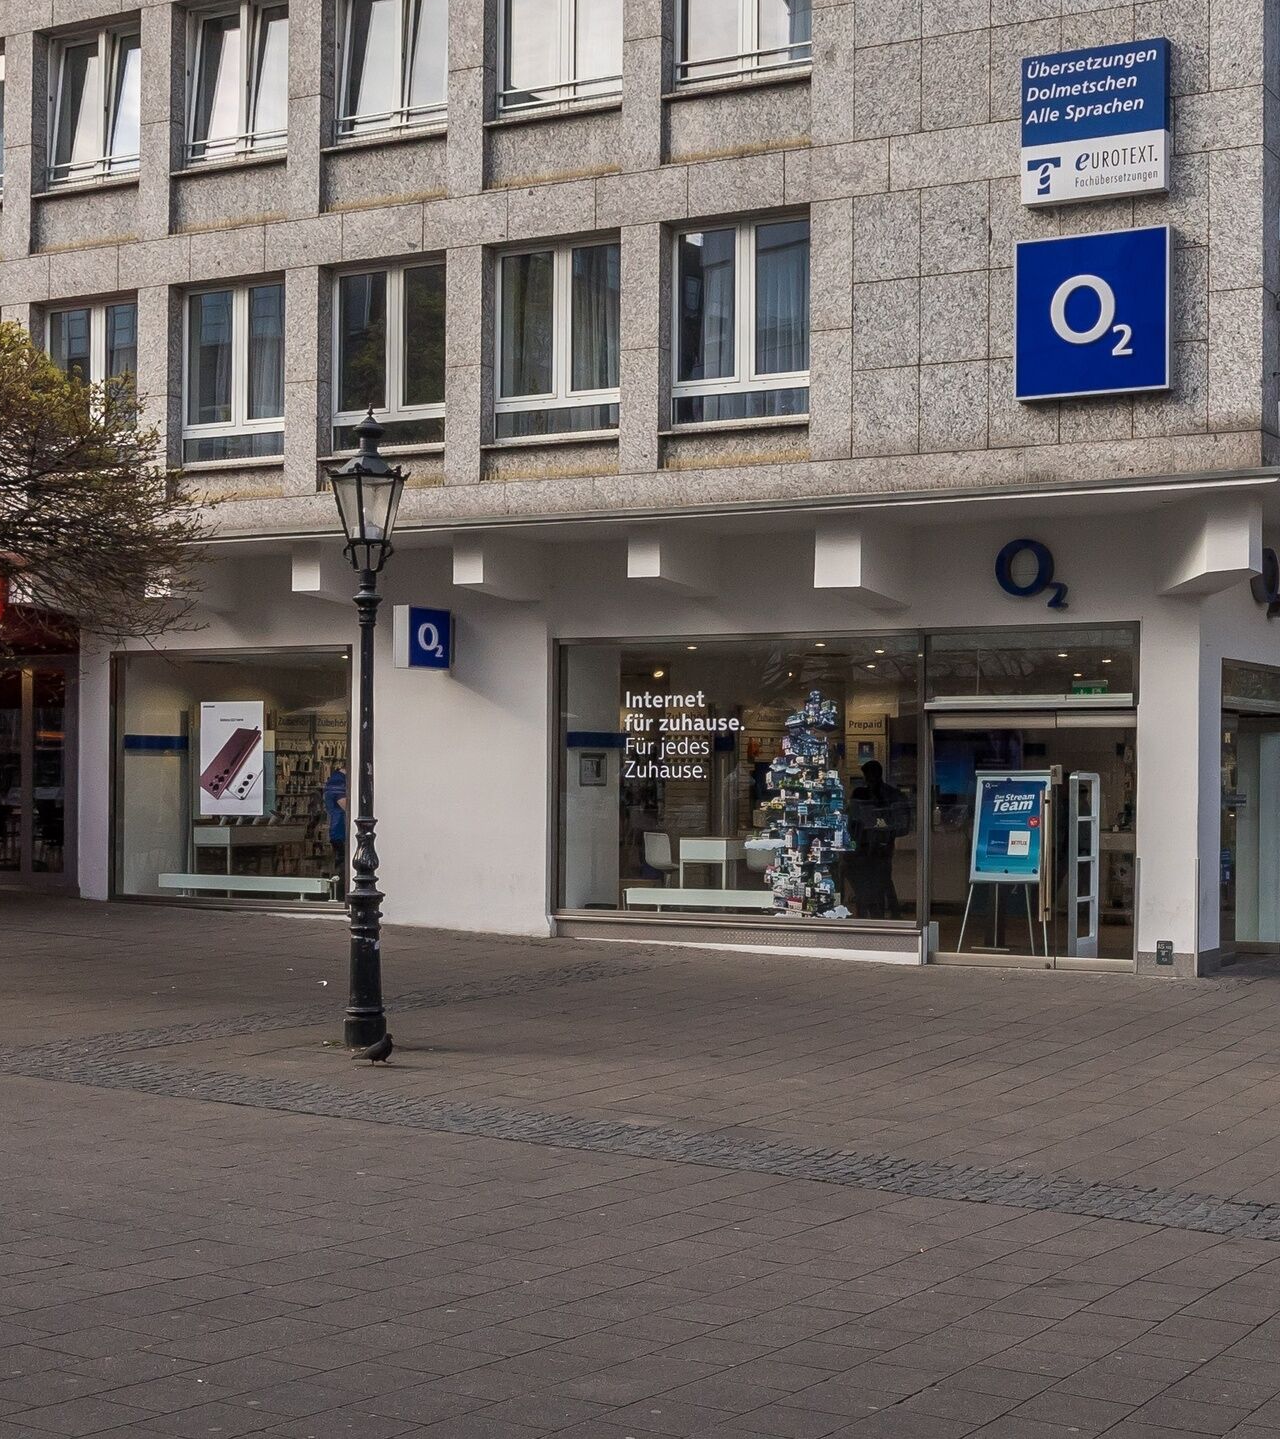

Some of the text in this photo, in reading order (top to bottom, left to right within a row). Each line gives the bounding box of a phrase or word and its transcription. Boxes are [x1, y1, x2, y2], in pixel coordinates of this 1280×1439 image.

[1027, 49, 1157, 79] Übersetzungen
[1026, 75, 1138, 102] Dolmetschen
[1025, 97, 1145, 125] Alle Sprachen
[1075, 170, 1158, 188] Fachübersetzungen
[1050, 274, 1133, 357] O2
[995, 538, 1069, 609] O2
[418, 622, 443, 658] O2
[625, 690, 705, 709] Internet
[624, 713, 655, 731] für
[659, 714, 746, 731] zuhause.
[848, 719, 883, 731] Prepaid
[625, 737, 710, 760] Für jedes
[624, 760, 708, 779] Zuhause.
[993, 800, 1033, 812] Team
[1005, 793, 1035, 801] Stream
